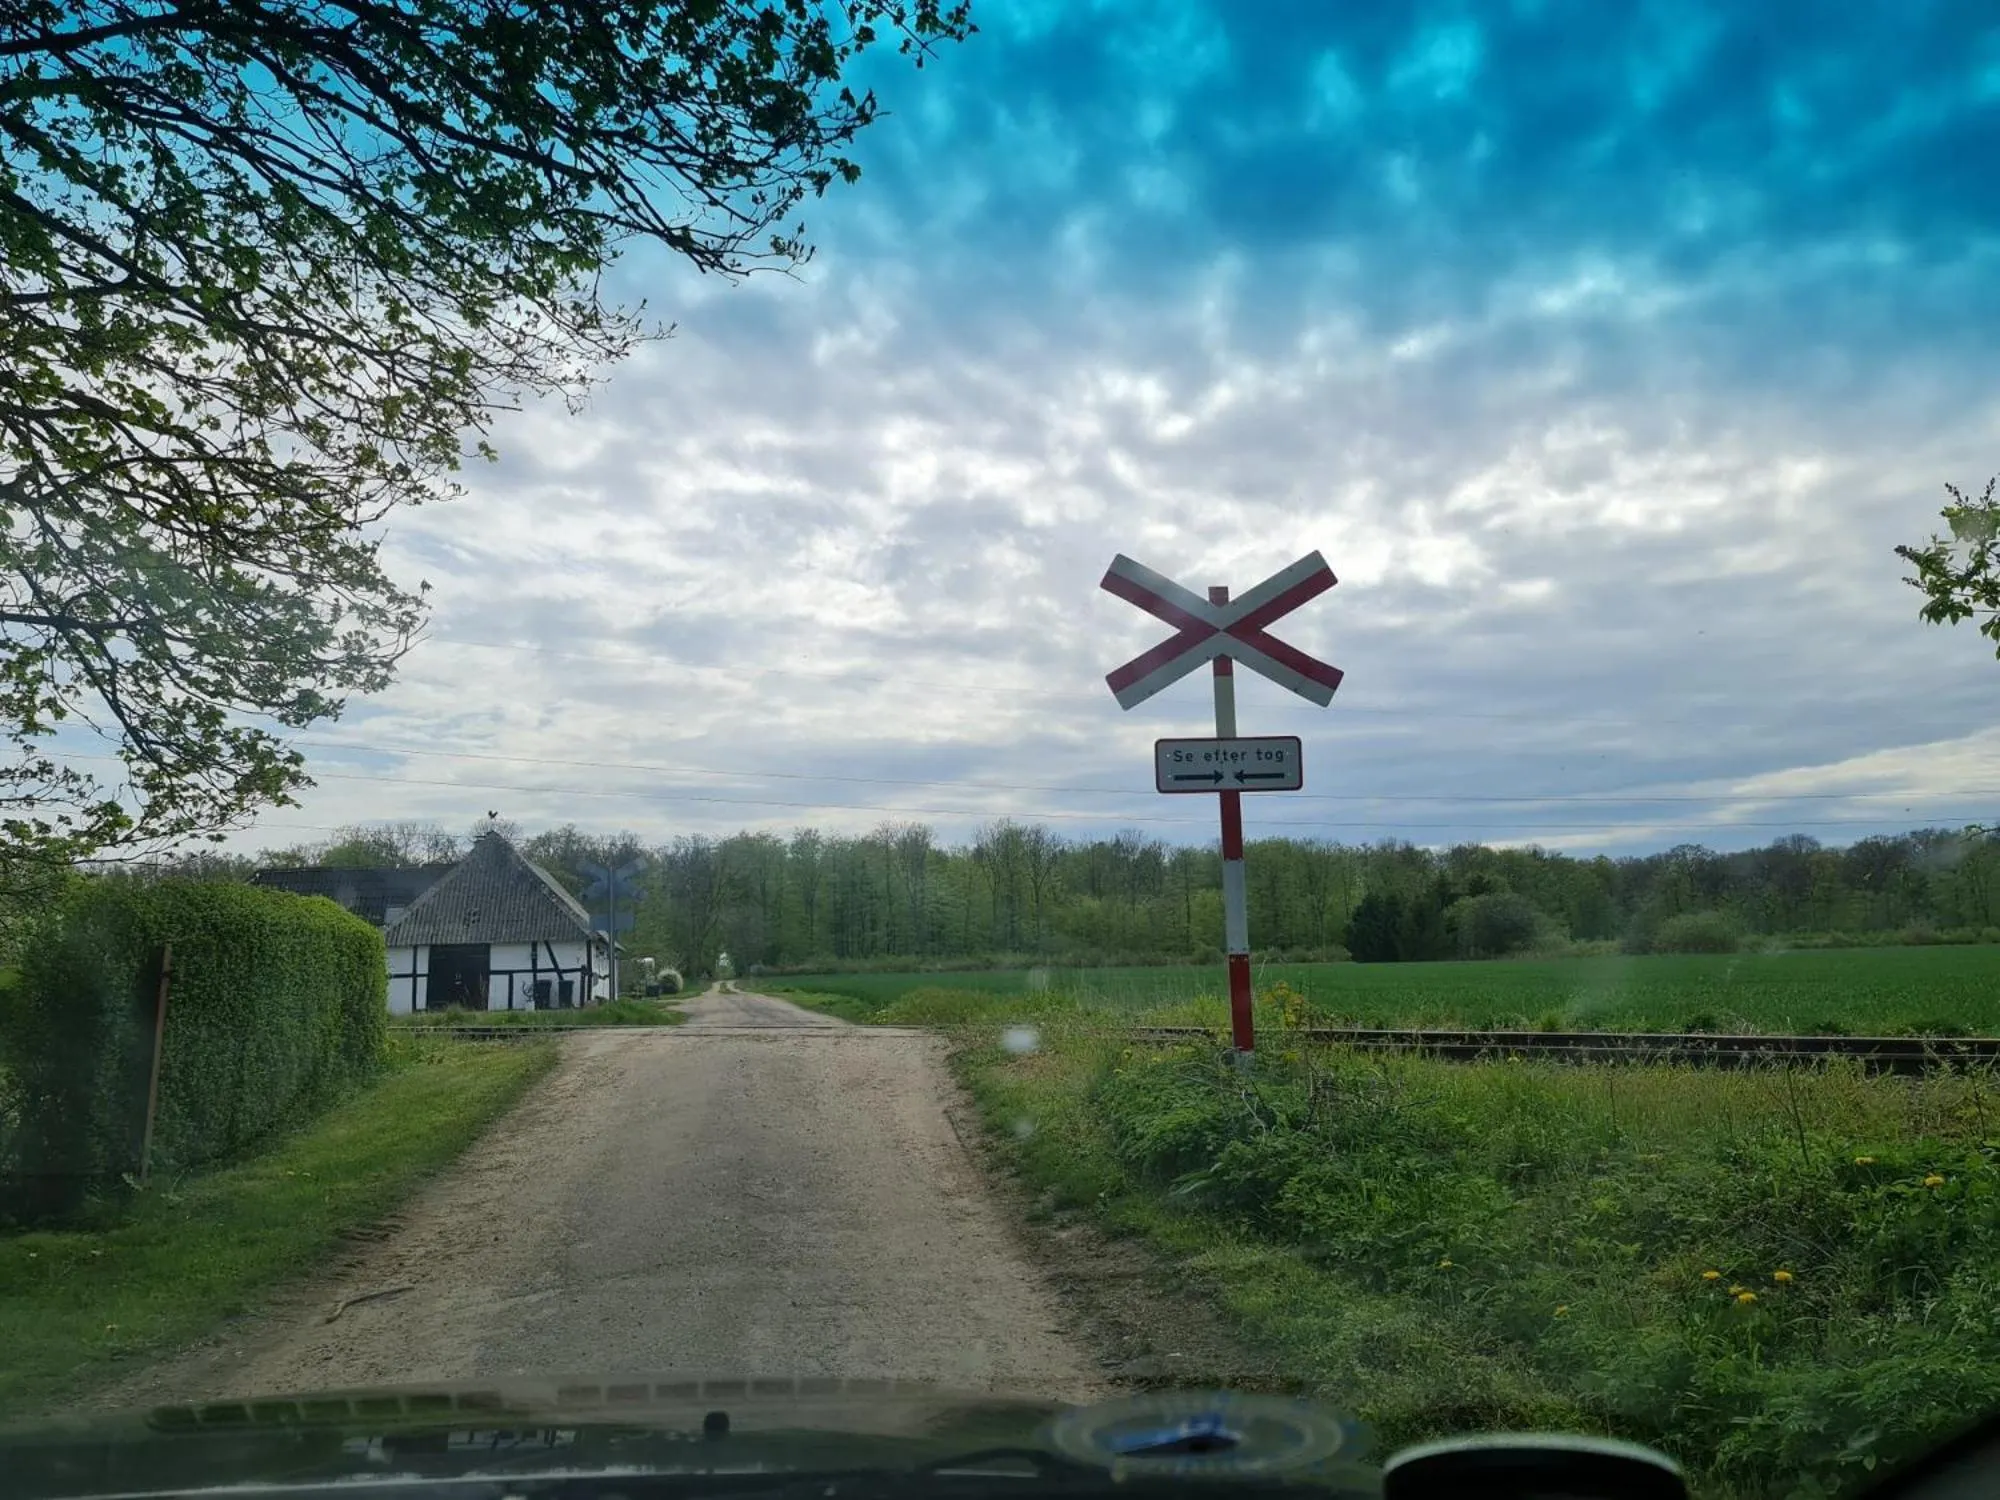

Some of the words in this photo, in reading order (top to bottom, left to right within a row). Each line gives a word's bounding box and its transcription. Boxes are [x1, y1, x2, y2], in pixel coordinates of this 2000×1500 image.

[1173, 750, 1194, 763] Se
[1203, 749, 1248, 763] efter
[1256, 747, 1284, 763] tog
